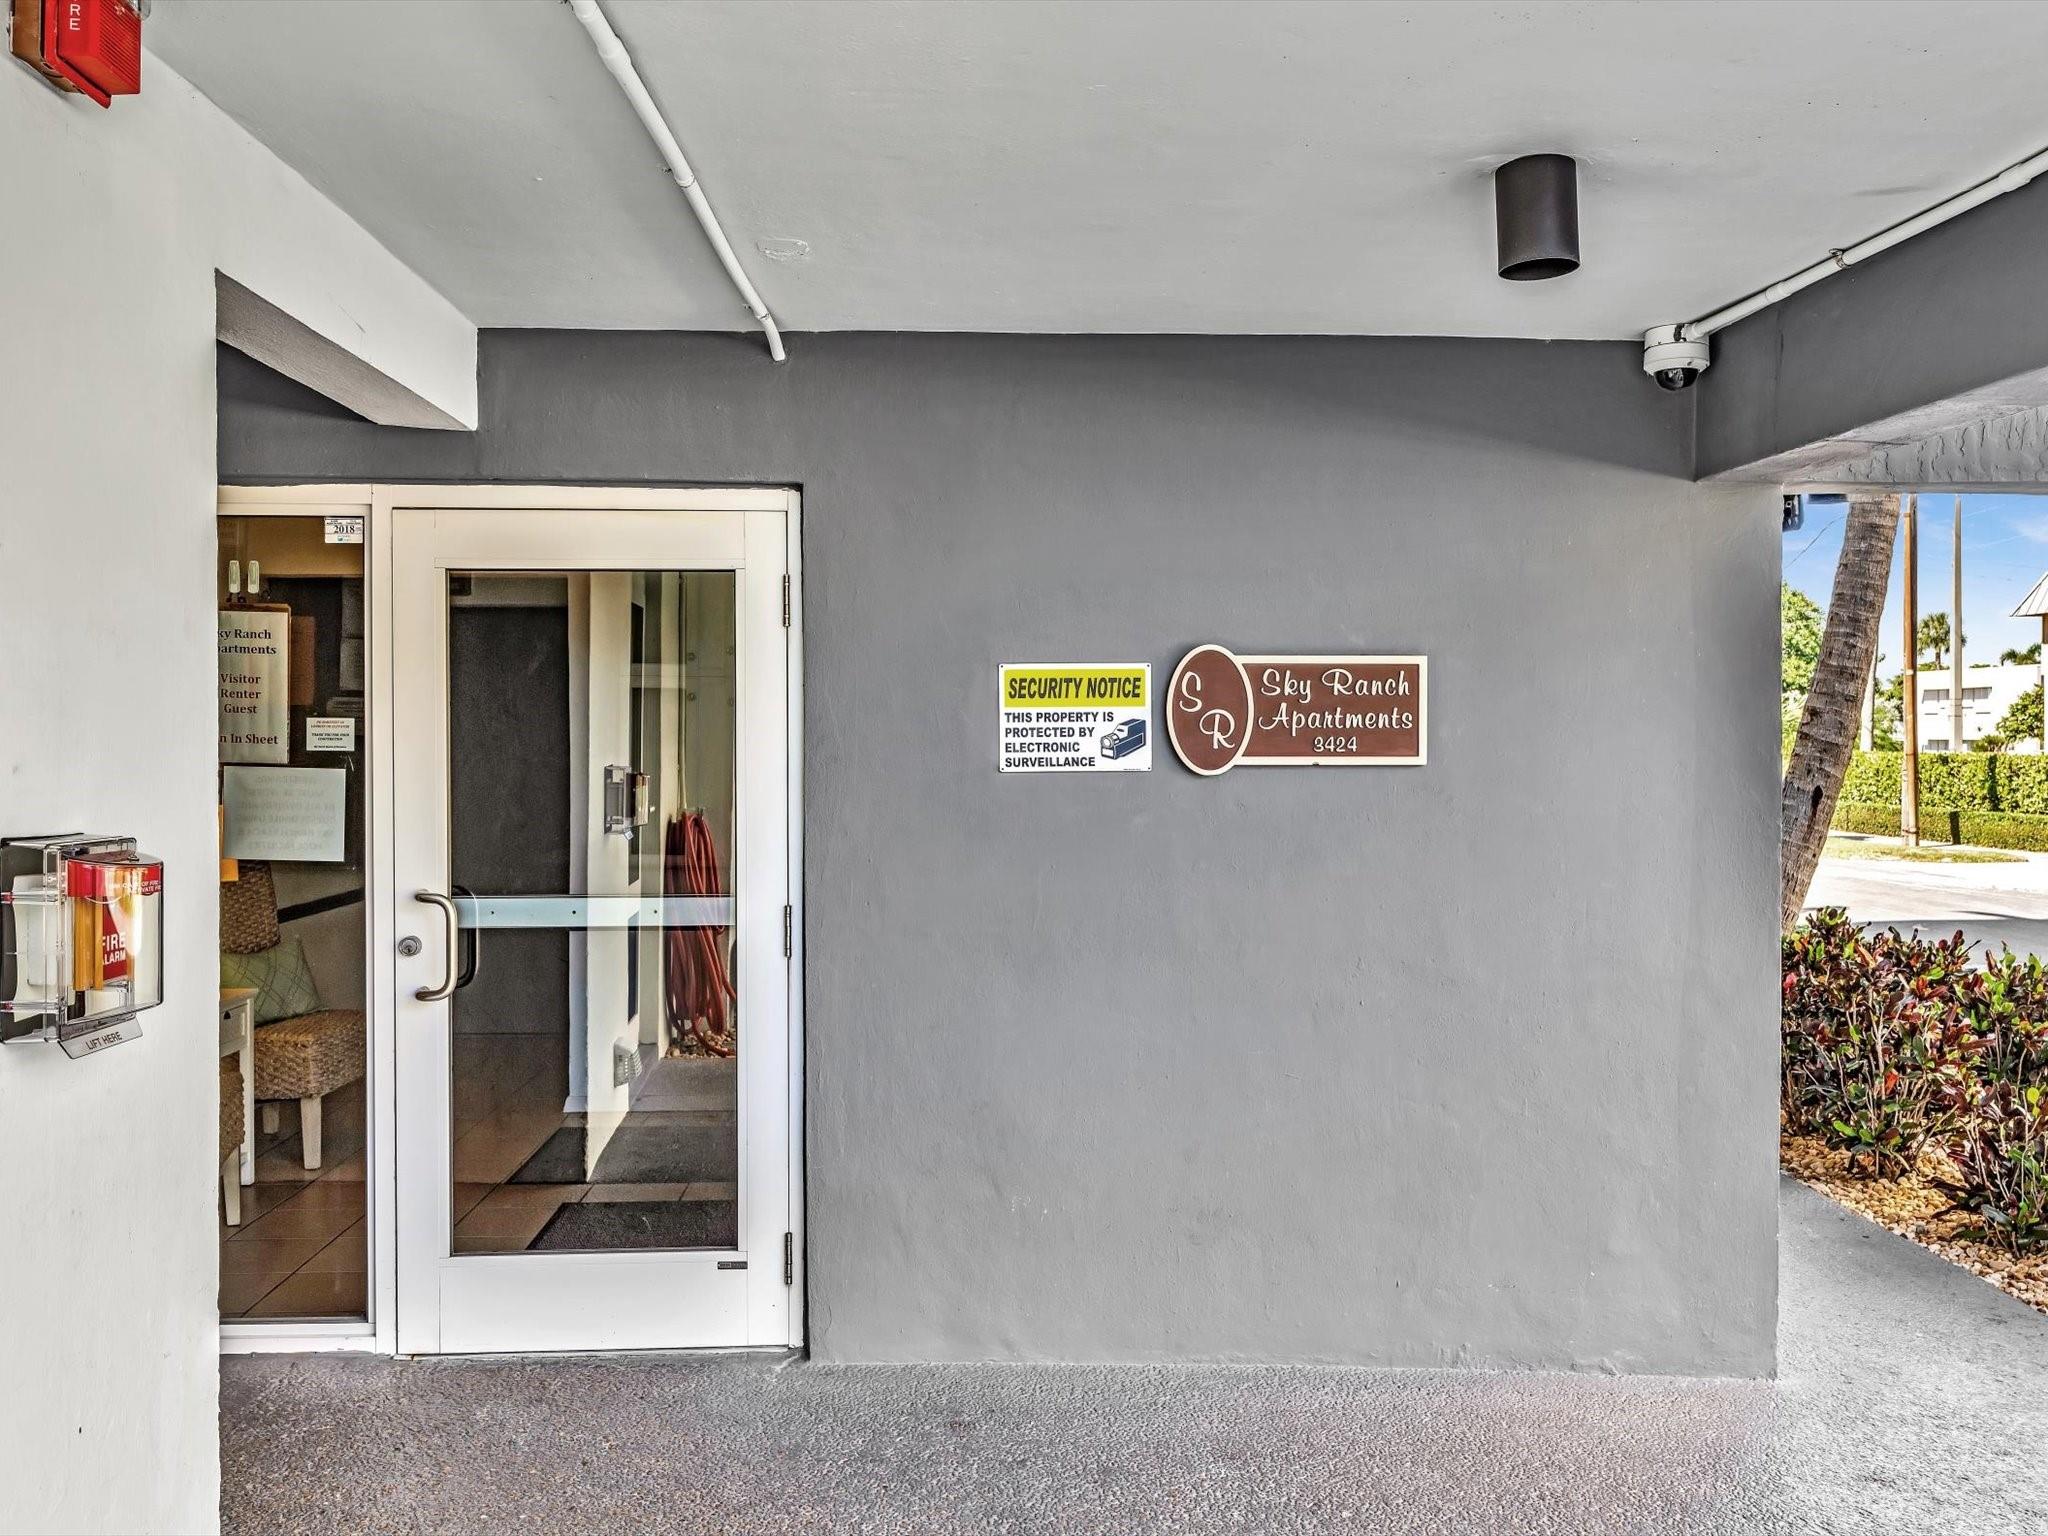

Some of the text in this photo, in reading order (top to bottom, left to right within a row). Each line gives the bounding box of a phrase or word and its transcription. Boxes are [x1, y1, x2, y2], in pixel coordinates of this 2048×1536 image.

[69, 0, 81, 31] RE
[333, 524, 355, 534] 2018
[217, 629, 272, 640] ky Ranch
[218, 645, 277, 655] artments
[220, 673, 262, 684] Visitor
[1008, 677, 1142, 699] SECURITY NOTICE
[1179, 671, 1203, 713] S
[1261, 668, 1410, 704] Sky Ranch
[220, 689, 262, 699] Renter
[223, 703, 258, 714] Guest
[1004, 711, 1115, 723] THIS PROPERTY IS
[1258, 702, 1413, 737] Apartments
[1005, 727, 1096, 738] PROTECTED BY
[1199, 708, 1236, 750] R
[230, 733, 243, 744] In
[245, 733, 279, 745] Sheet
[1313, 736, 1358, 752] 3424
[1005, 742, 1080, 753] ELECTRONIC
[1004, 757, 1096, 768] SURVEILLANCE
[102, 949, 126, 965] LARM
[85, 1031, 123, 1050] LIFT HERE
